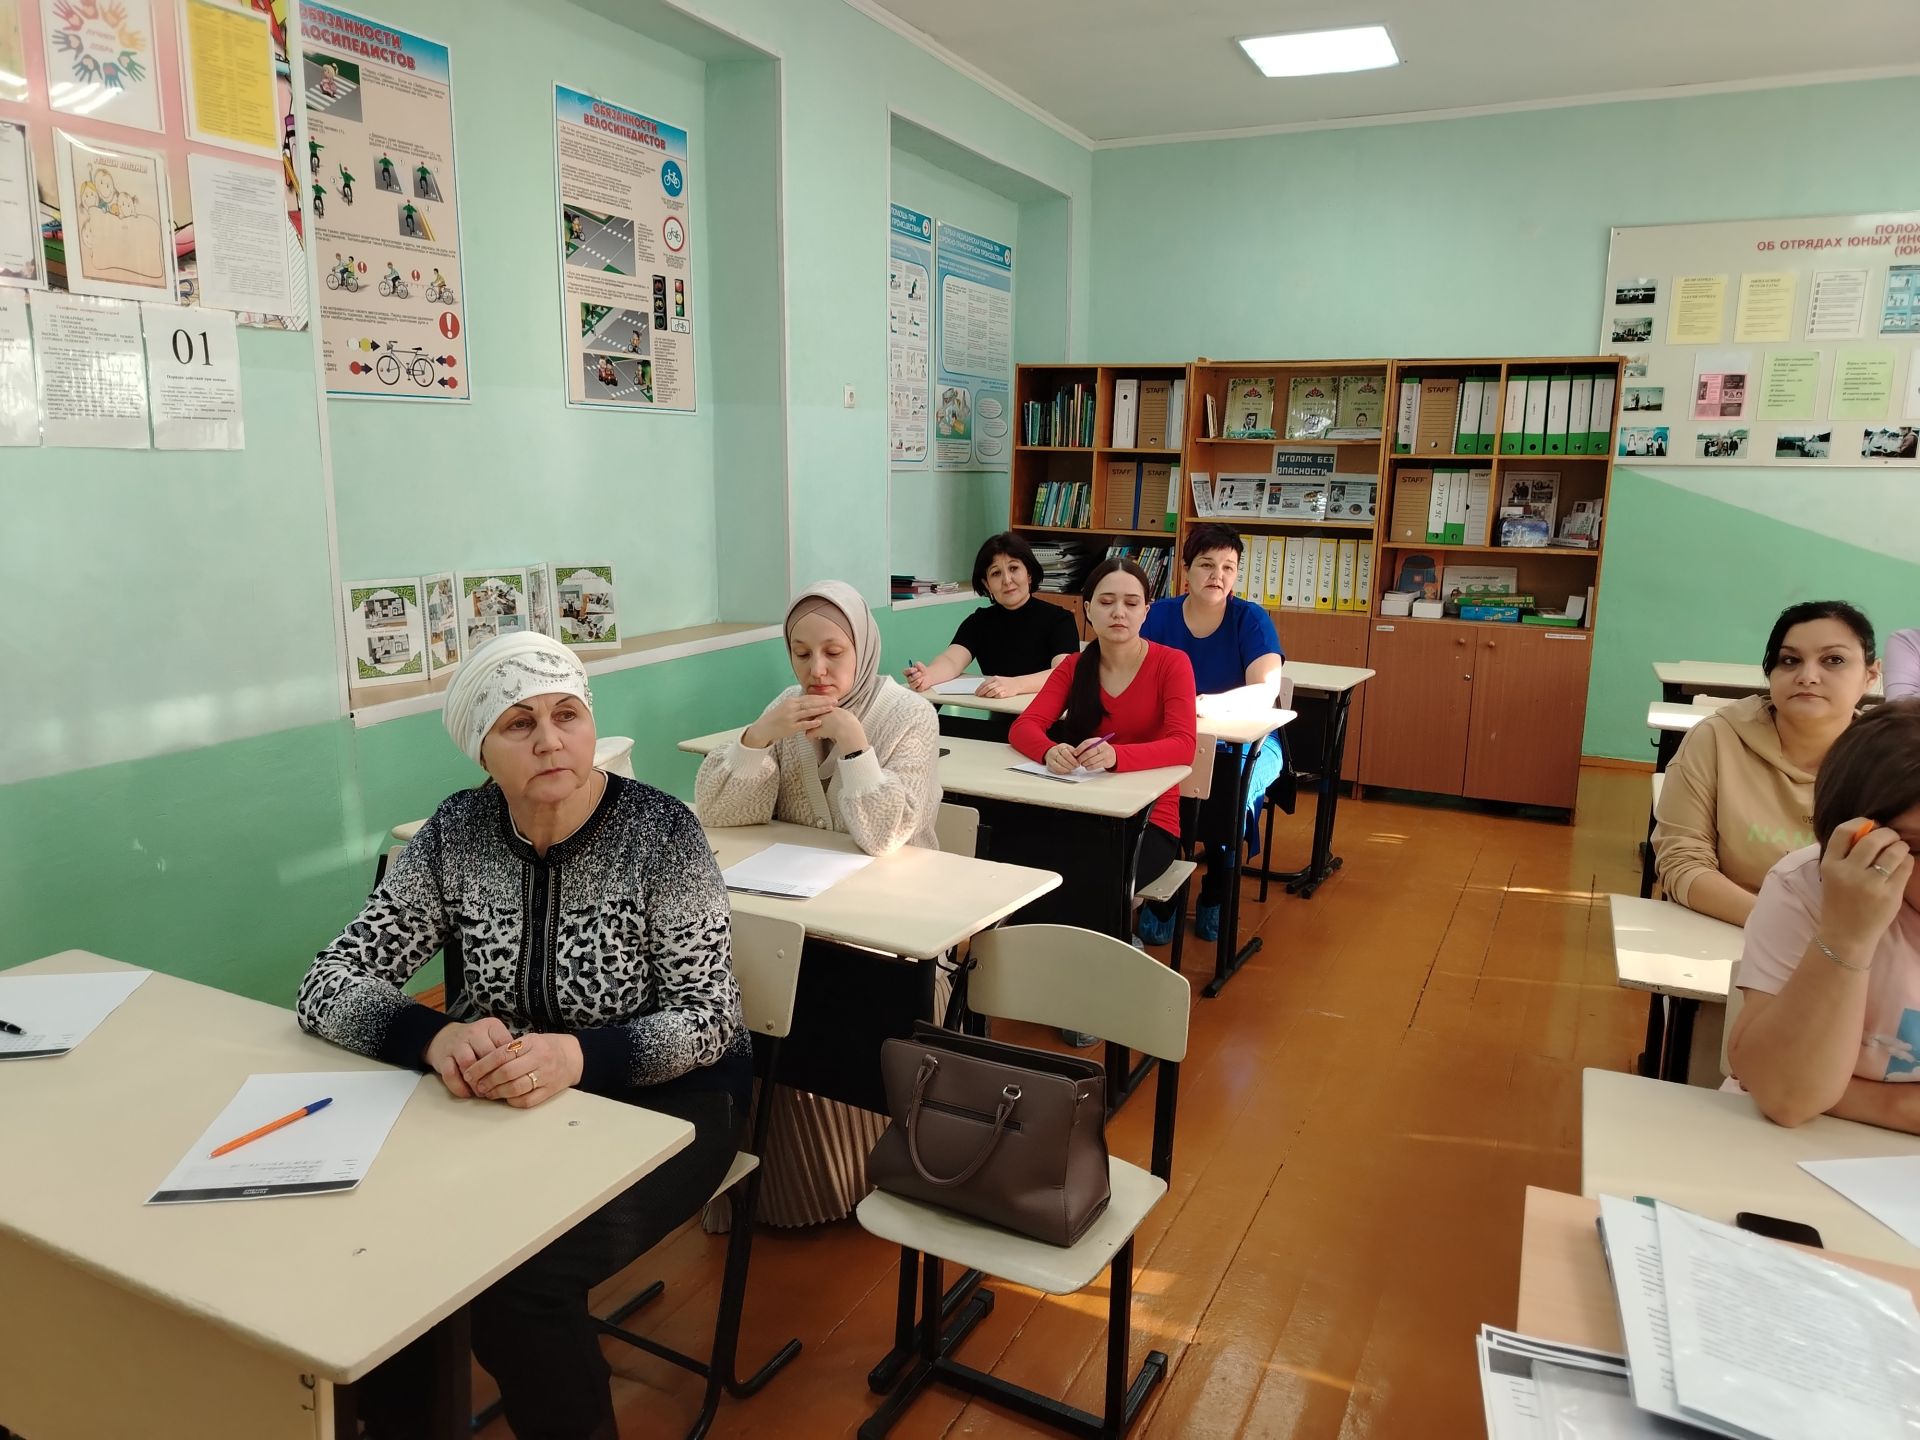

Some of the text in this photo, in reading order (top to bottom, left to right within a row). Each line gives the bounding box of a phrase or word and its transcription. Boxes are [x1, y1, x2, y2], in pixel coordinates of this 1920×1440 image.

[592, 102, 658, 134] ОБЯЗАННОСТИ
[583, 112, 666, 150] ВЕЛОСИПЕДИСТОВ
[1756, 241, 1775, 251] ОБ
[1780, 237, 1842, 250] ОТРЯДАХ
[1847, 235, 1891, 247] ЮНЫХ
[172, 328, 213, 367] 01
[1277, 466, 1328, 476] ОПАСНОСТИ
[1279, 454, 1334, 464] УГОЛОК БЕЗ
